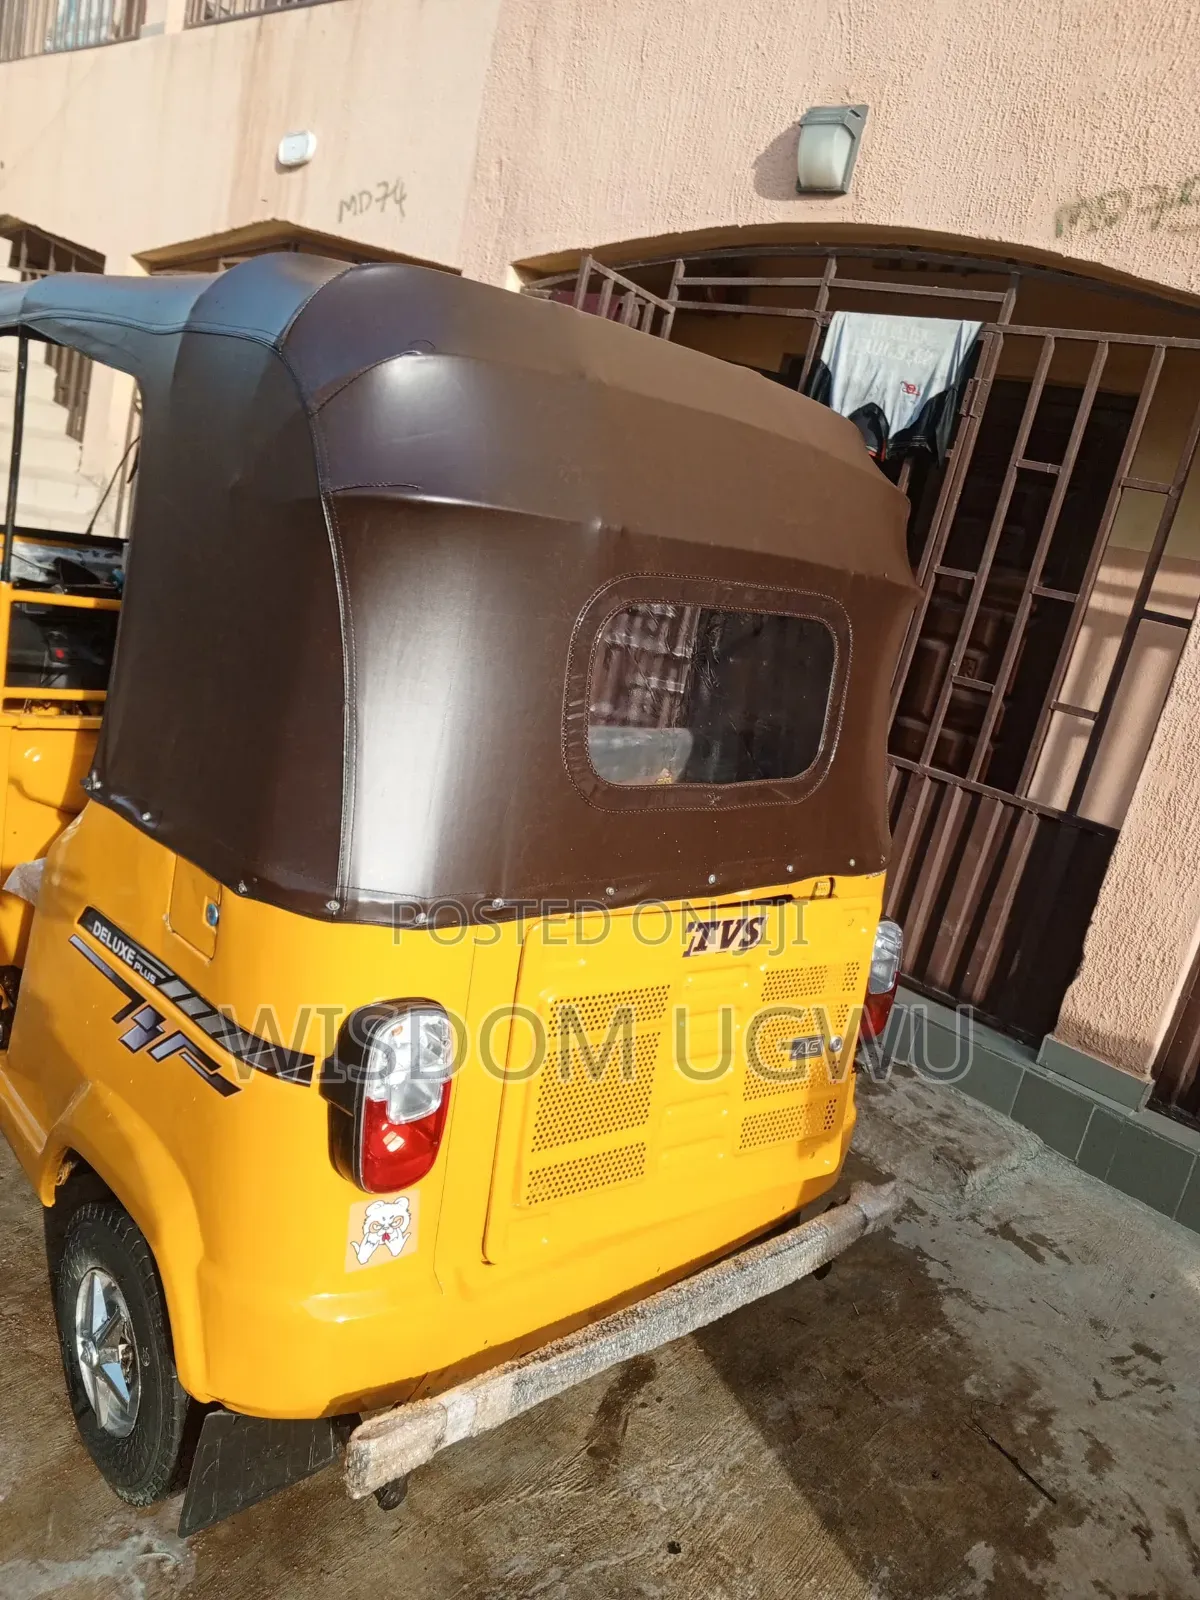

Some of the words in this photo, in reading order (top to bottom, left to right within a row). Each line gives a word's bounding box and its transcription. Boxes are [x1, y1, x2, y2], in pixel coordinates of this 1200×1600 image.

[337, 176, 407, 224] MD74
[92, 920, 137, 966] DELUXE
[133, 961, 157, 985] PLUS
[683, 915, 767, 958] TVS
